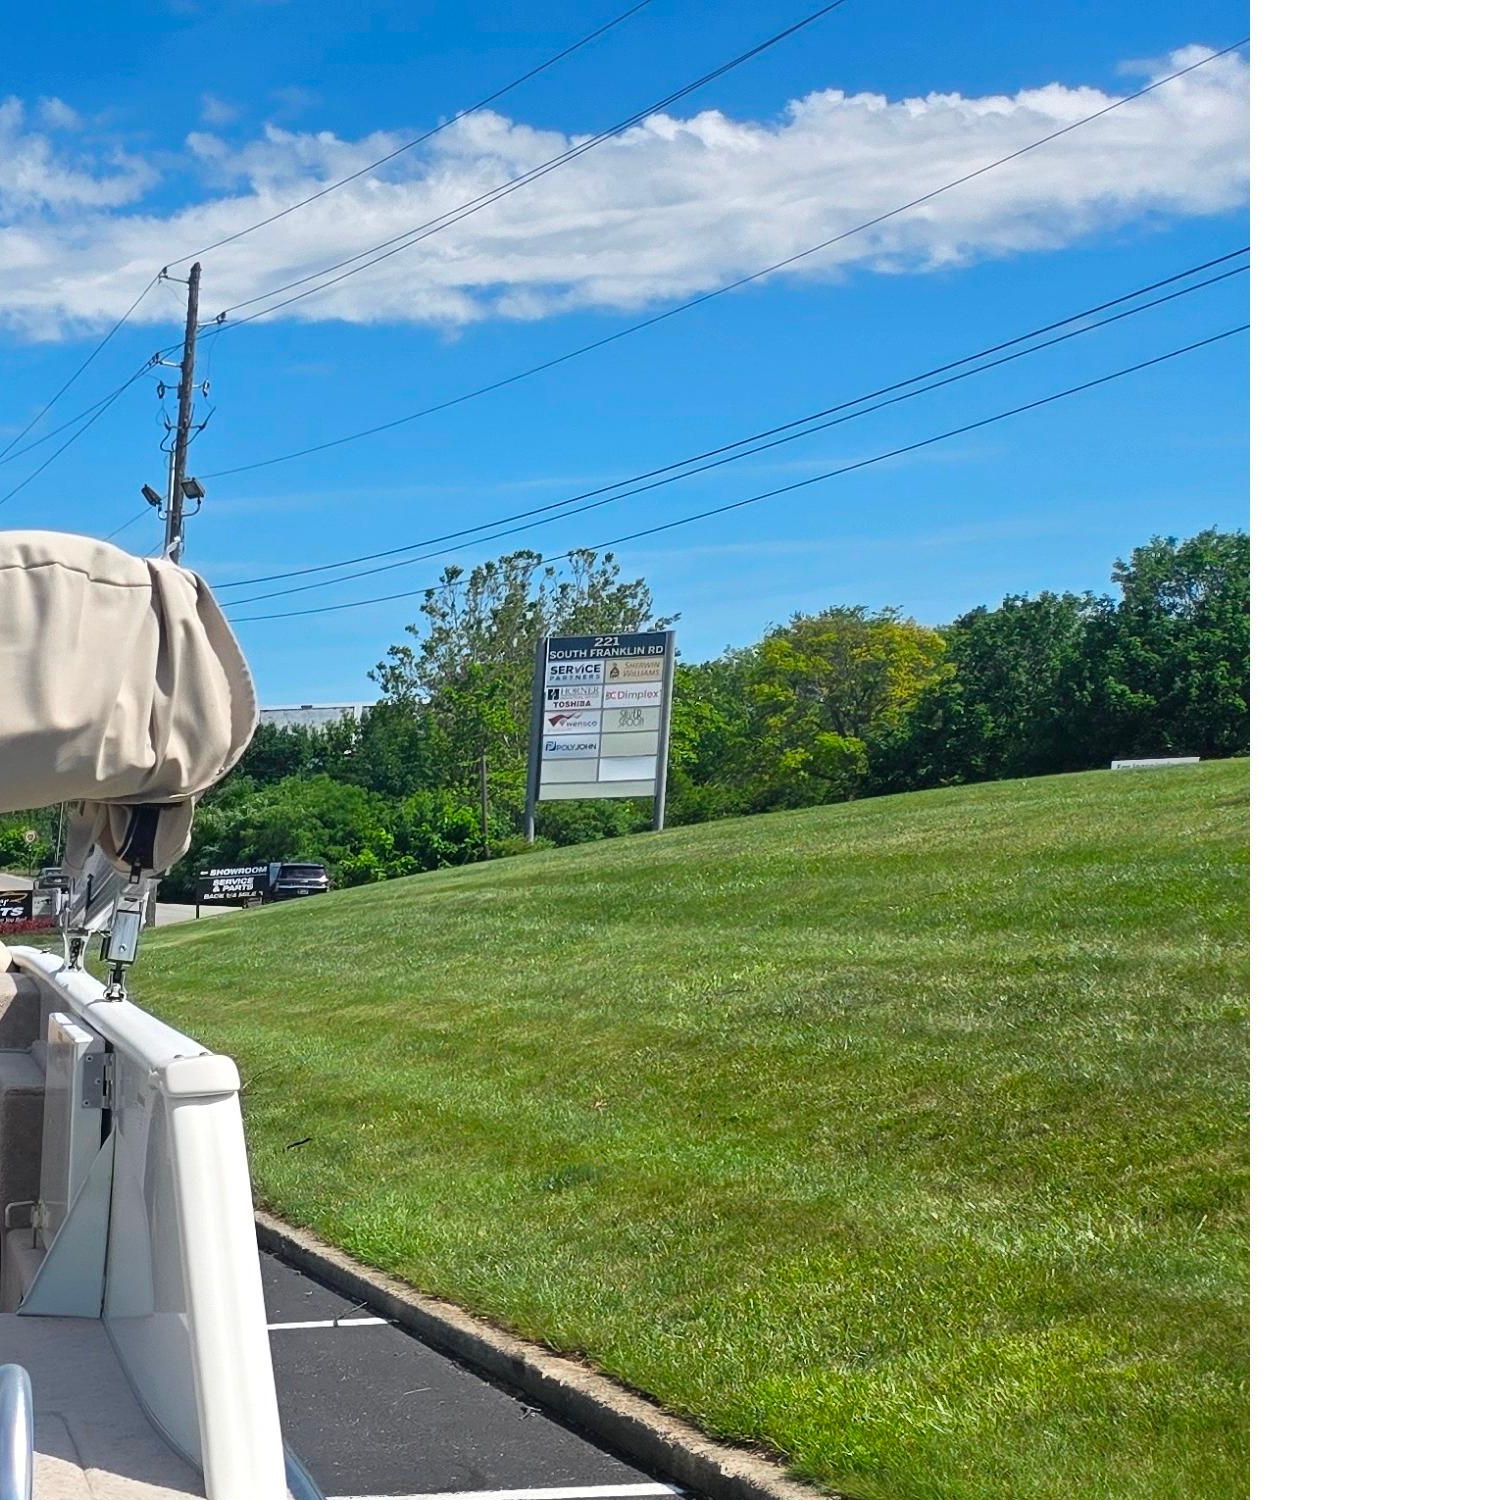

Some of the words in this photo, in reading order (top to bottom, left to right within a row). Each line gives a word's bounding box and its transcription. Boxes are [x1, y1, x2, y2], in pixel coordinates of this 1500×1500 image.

[593, 636, 620, 647] 221
[549, 648, 587, 660] SOUTH
[589, 645, 645, 657] FRANKLIN
[647, 645, 664, 654] RD
[553, 700, 591, 708] TOSHIBA
[209, 866, 268, 876] SHOWROOM
[212, 877, 255, 886] SERVICE
[221, 883, 254, 892] PARTS
